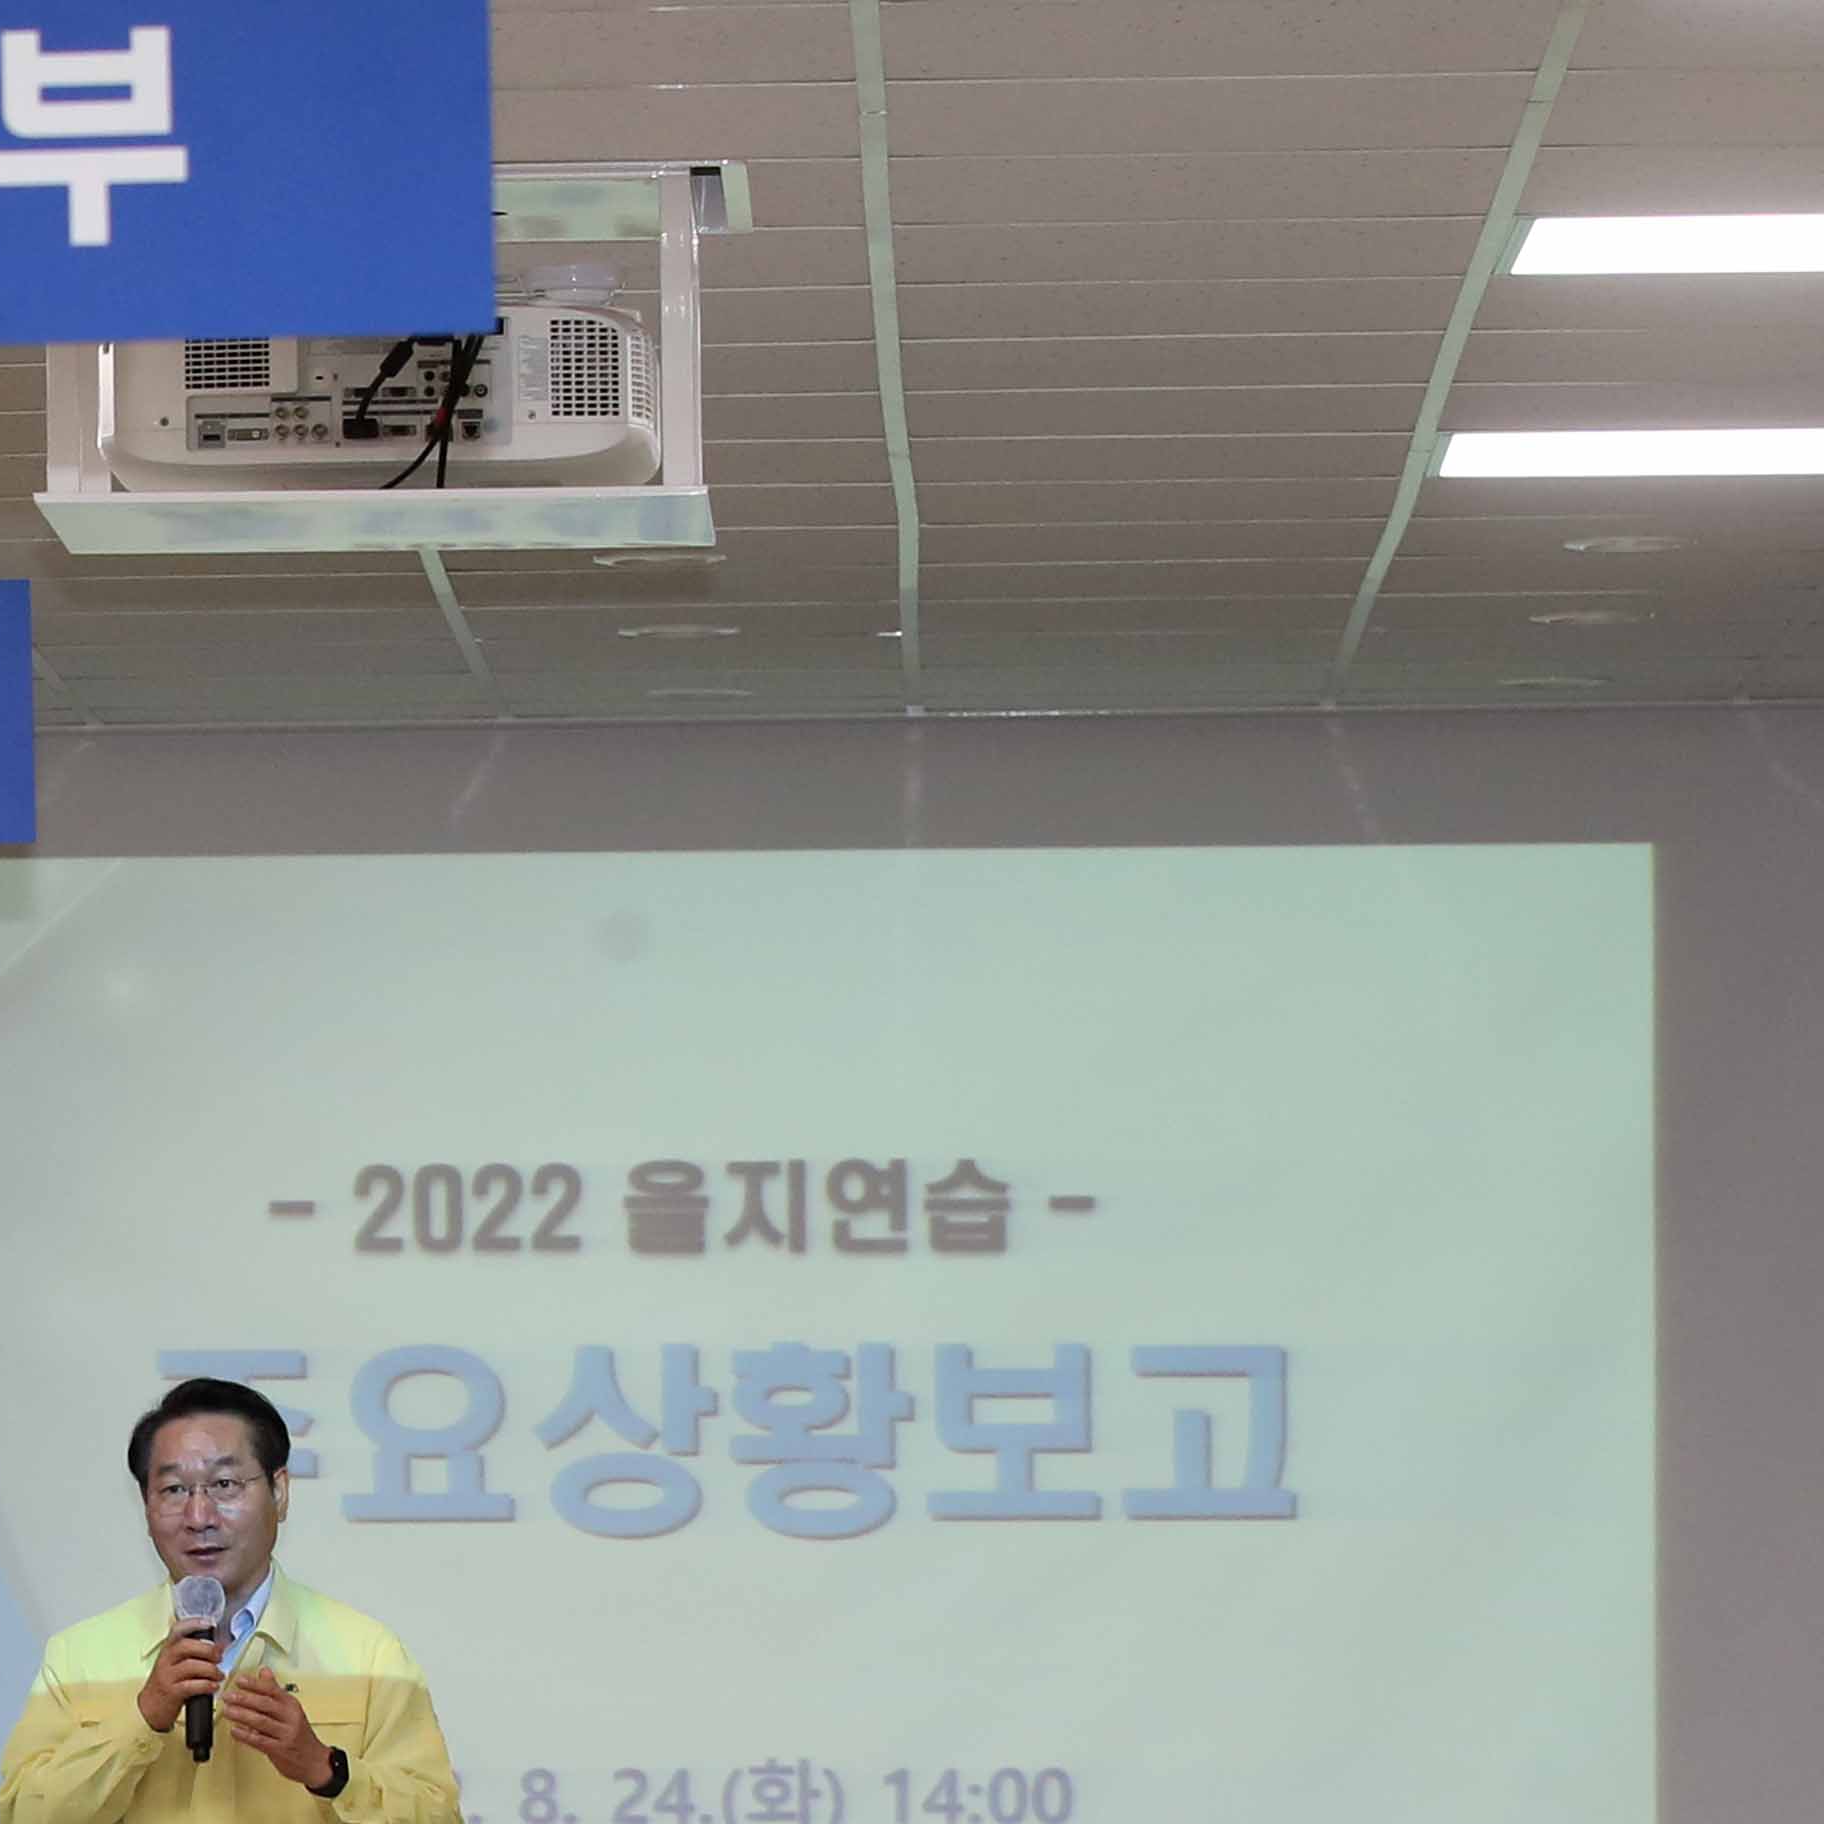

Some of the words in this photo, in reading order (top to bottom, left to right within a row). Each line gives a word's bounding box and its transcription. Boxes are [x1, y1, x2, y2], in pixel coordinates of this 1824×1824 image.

[354, 1163, 585, 1252] 2022
[624, 1158, 1013, 1256] 을지연습
[157, 1342, 1298, 1540] 요상황보고
